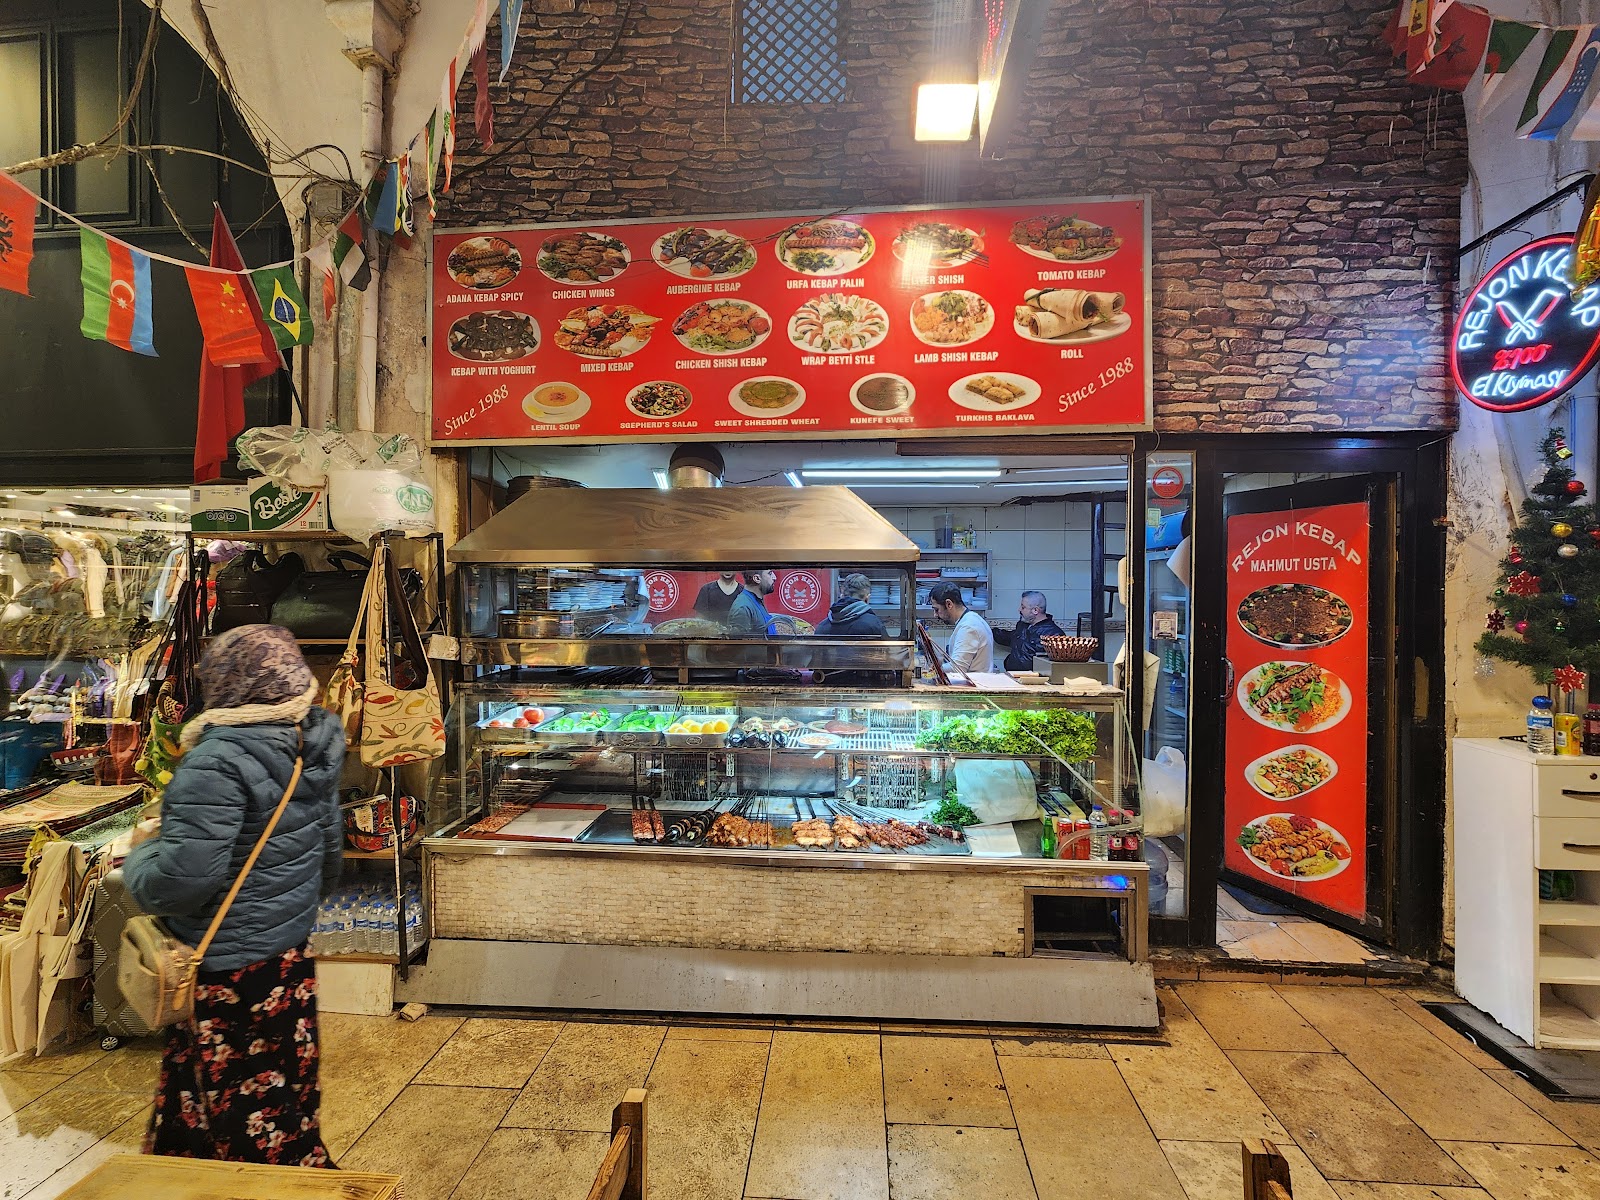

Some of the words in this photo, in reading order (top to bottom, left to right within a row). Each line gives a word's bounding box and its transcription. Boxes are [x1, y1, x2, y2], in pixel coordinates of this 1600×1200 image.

[937, 274, 965, 285] SHISH
[1037, 270, 1075, 281] TOMATO
[1076, 268, 1106, 280] KEBAP
[666, 283, 713, 295] AUBERGINE
[714, 282, 742, 293] KEBAP
[786, 279, 809, 290] URFA
[810, 278, 839, 289] KEBAP
[839, 277, 865, 288] PALIN
[446, 294, 472, 304] ADANA
[473, 293, 499, 303] KEBAP
[500, 291, 525, 302] SPICY
[552, 289, 587, 300] CHICKEN
[588, 287, 616, 299] WINGS
[1458, 255, 1531, 351] REJON
[1532, 248, 1600, 327] KEAP
[801, 356, 827, 366] WRAP
[854, 354, 876, 365] STLE
[914, 353, 939, 364] LAMB
[941, 352, 967, 363] SHISH
[969, 351, 999, 362] KEBAP
[1060, 348, 1084, 360] ROLL
[580, 363, 605, 373] MIXED
[607, 362, 634, 372] KEBAP
[675, 359, 711, 370] CHICKEN
[712, 358, 738, 369] SHISH
[739, 357, 768, 368] KEBAP
[451, 366, 477, 377] KEBAP
[477, 365, 499, 376] WITH
[499, 364, 537, 375] YOGHURT
[1058, 382, 1097, 413] Since
[1098, 357, 1134, 389] 1988
[444, 407, 477, 436] Since
[478, 384, 509, 414] 1988
[671, 420, 699, 428] SALAD
[714, 419, 742, 428] SWEET
[743, 418, 788, 427] SHREDDED
[790, 417, 821, 426] WHEAT
[849, 416, 885, 425] KUNEFE
[885, 415, 916, 425] SWEET
[955, 414, 994, 423] TURKHIS
[995, 412, 1036, 422] BAKLAVA
[530, 423, 557, 432] LENTIL
[558, 422, 582, 431] SOUP
[1231, 522, 1289, 573] REJON
[1295, 521, 1362, 566] KEBAP
[1250, 557, 1301, 573] MAHMUT
[1303, 556, 1338, 572] USTA
